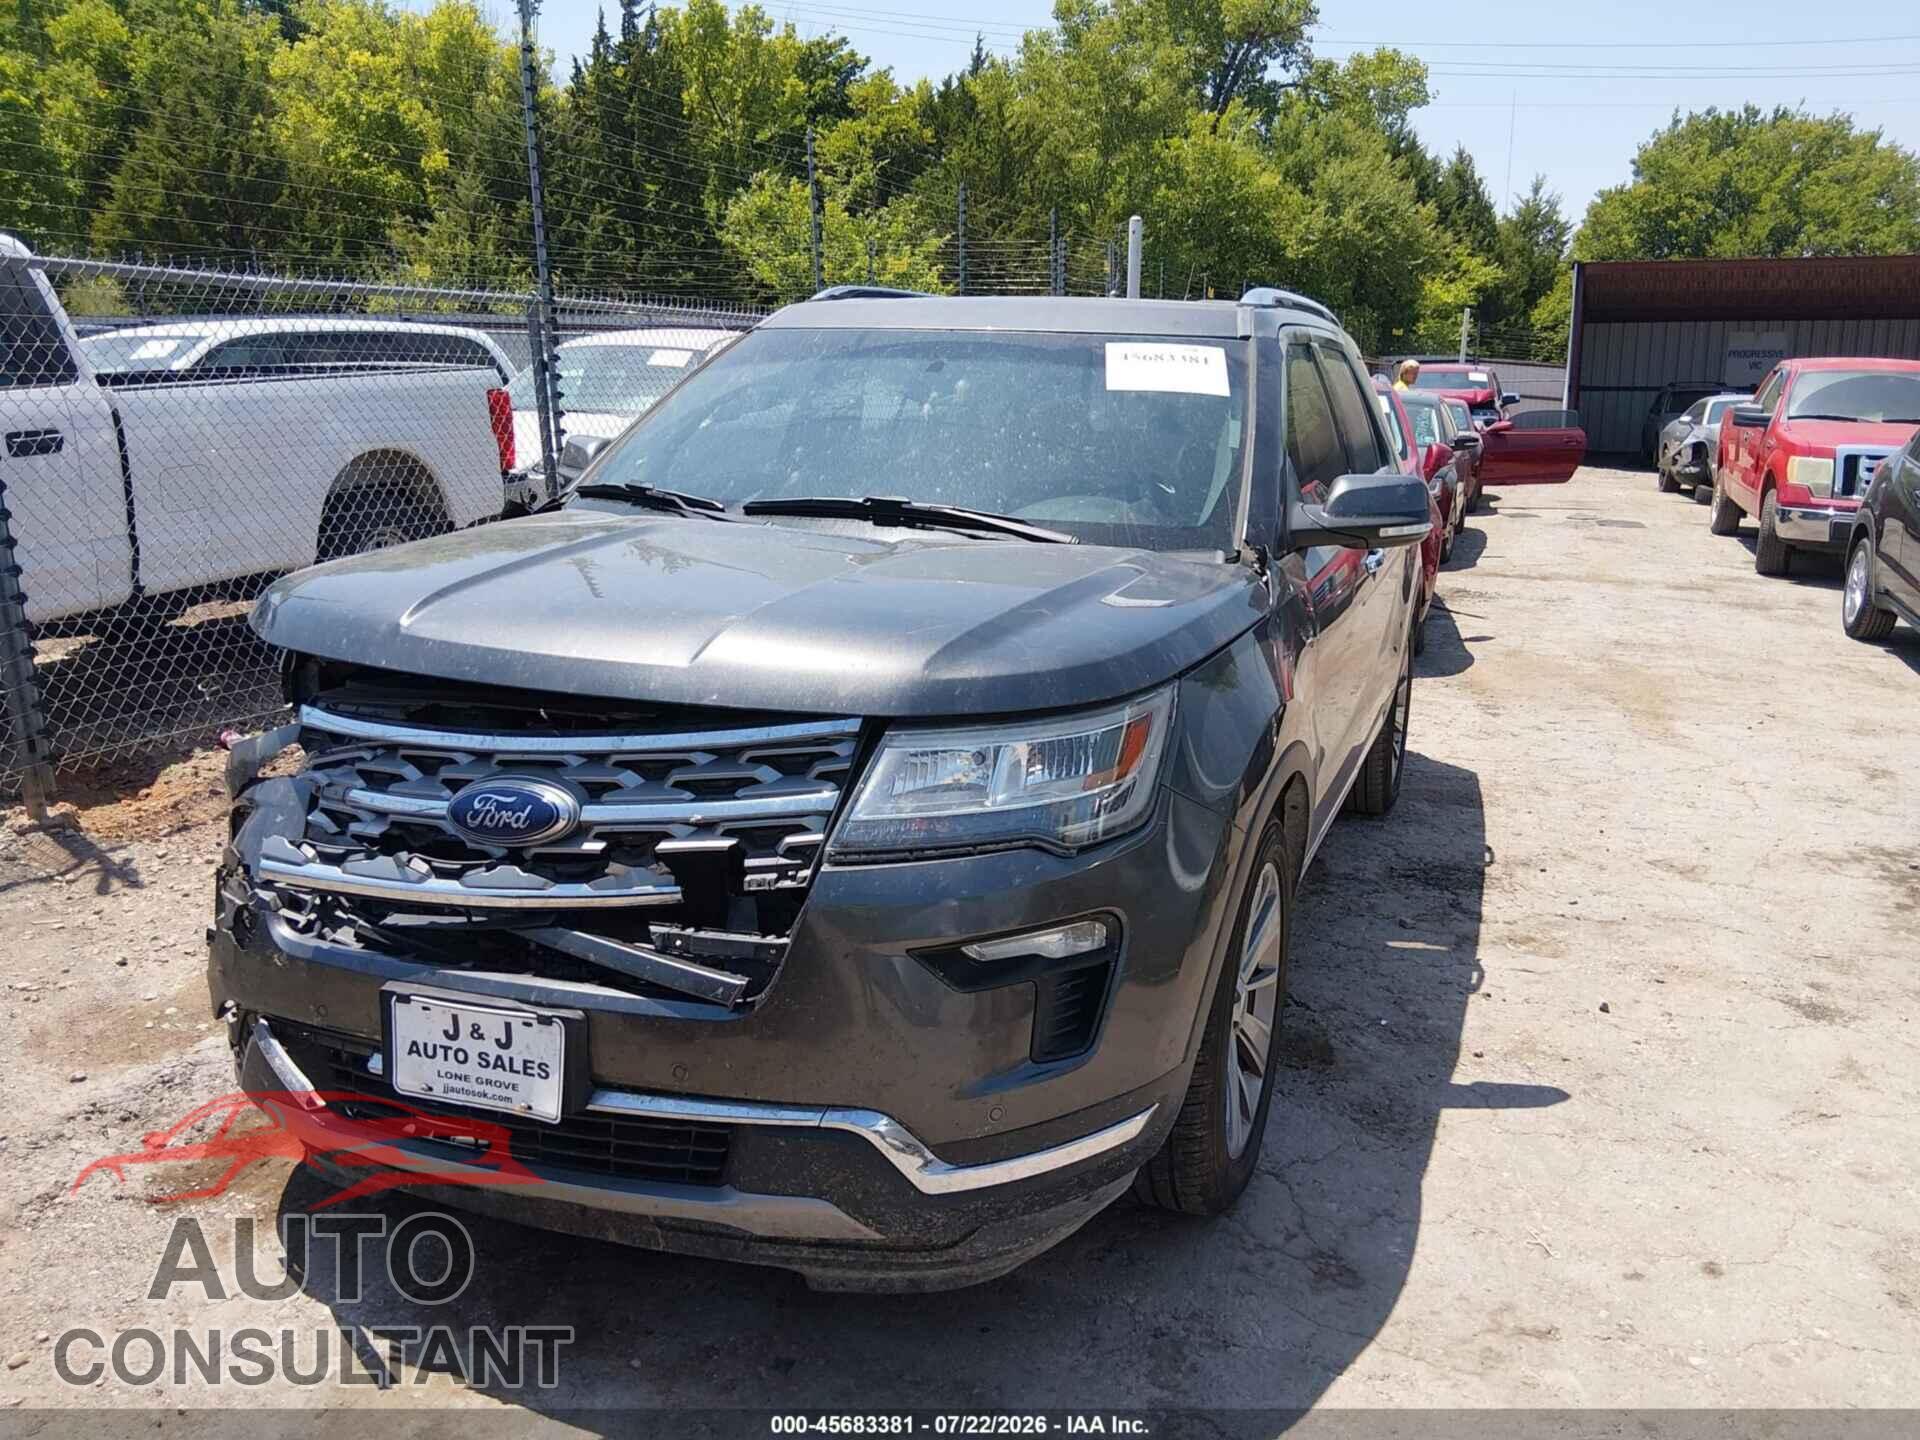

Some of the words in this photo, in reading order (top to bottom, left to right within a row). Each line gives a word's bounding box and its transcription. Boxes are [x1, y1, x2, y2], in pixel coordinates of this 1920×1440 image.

[466, 793, 533, 829] Ford
[443, 1013, 460, 1041] J
[470, 1023, 485, 1041] &
[494, 1021, 513, 1050] J
[407, 1040, 469, 1065] AUTO
[477, 1051, 550, 1080] SALES
[437, 1070, 471, 1083] LONE
[475, 1076, 520, 1092] GROVE
[442, 1083, 513, 1104] jjautosok.com
